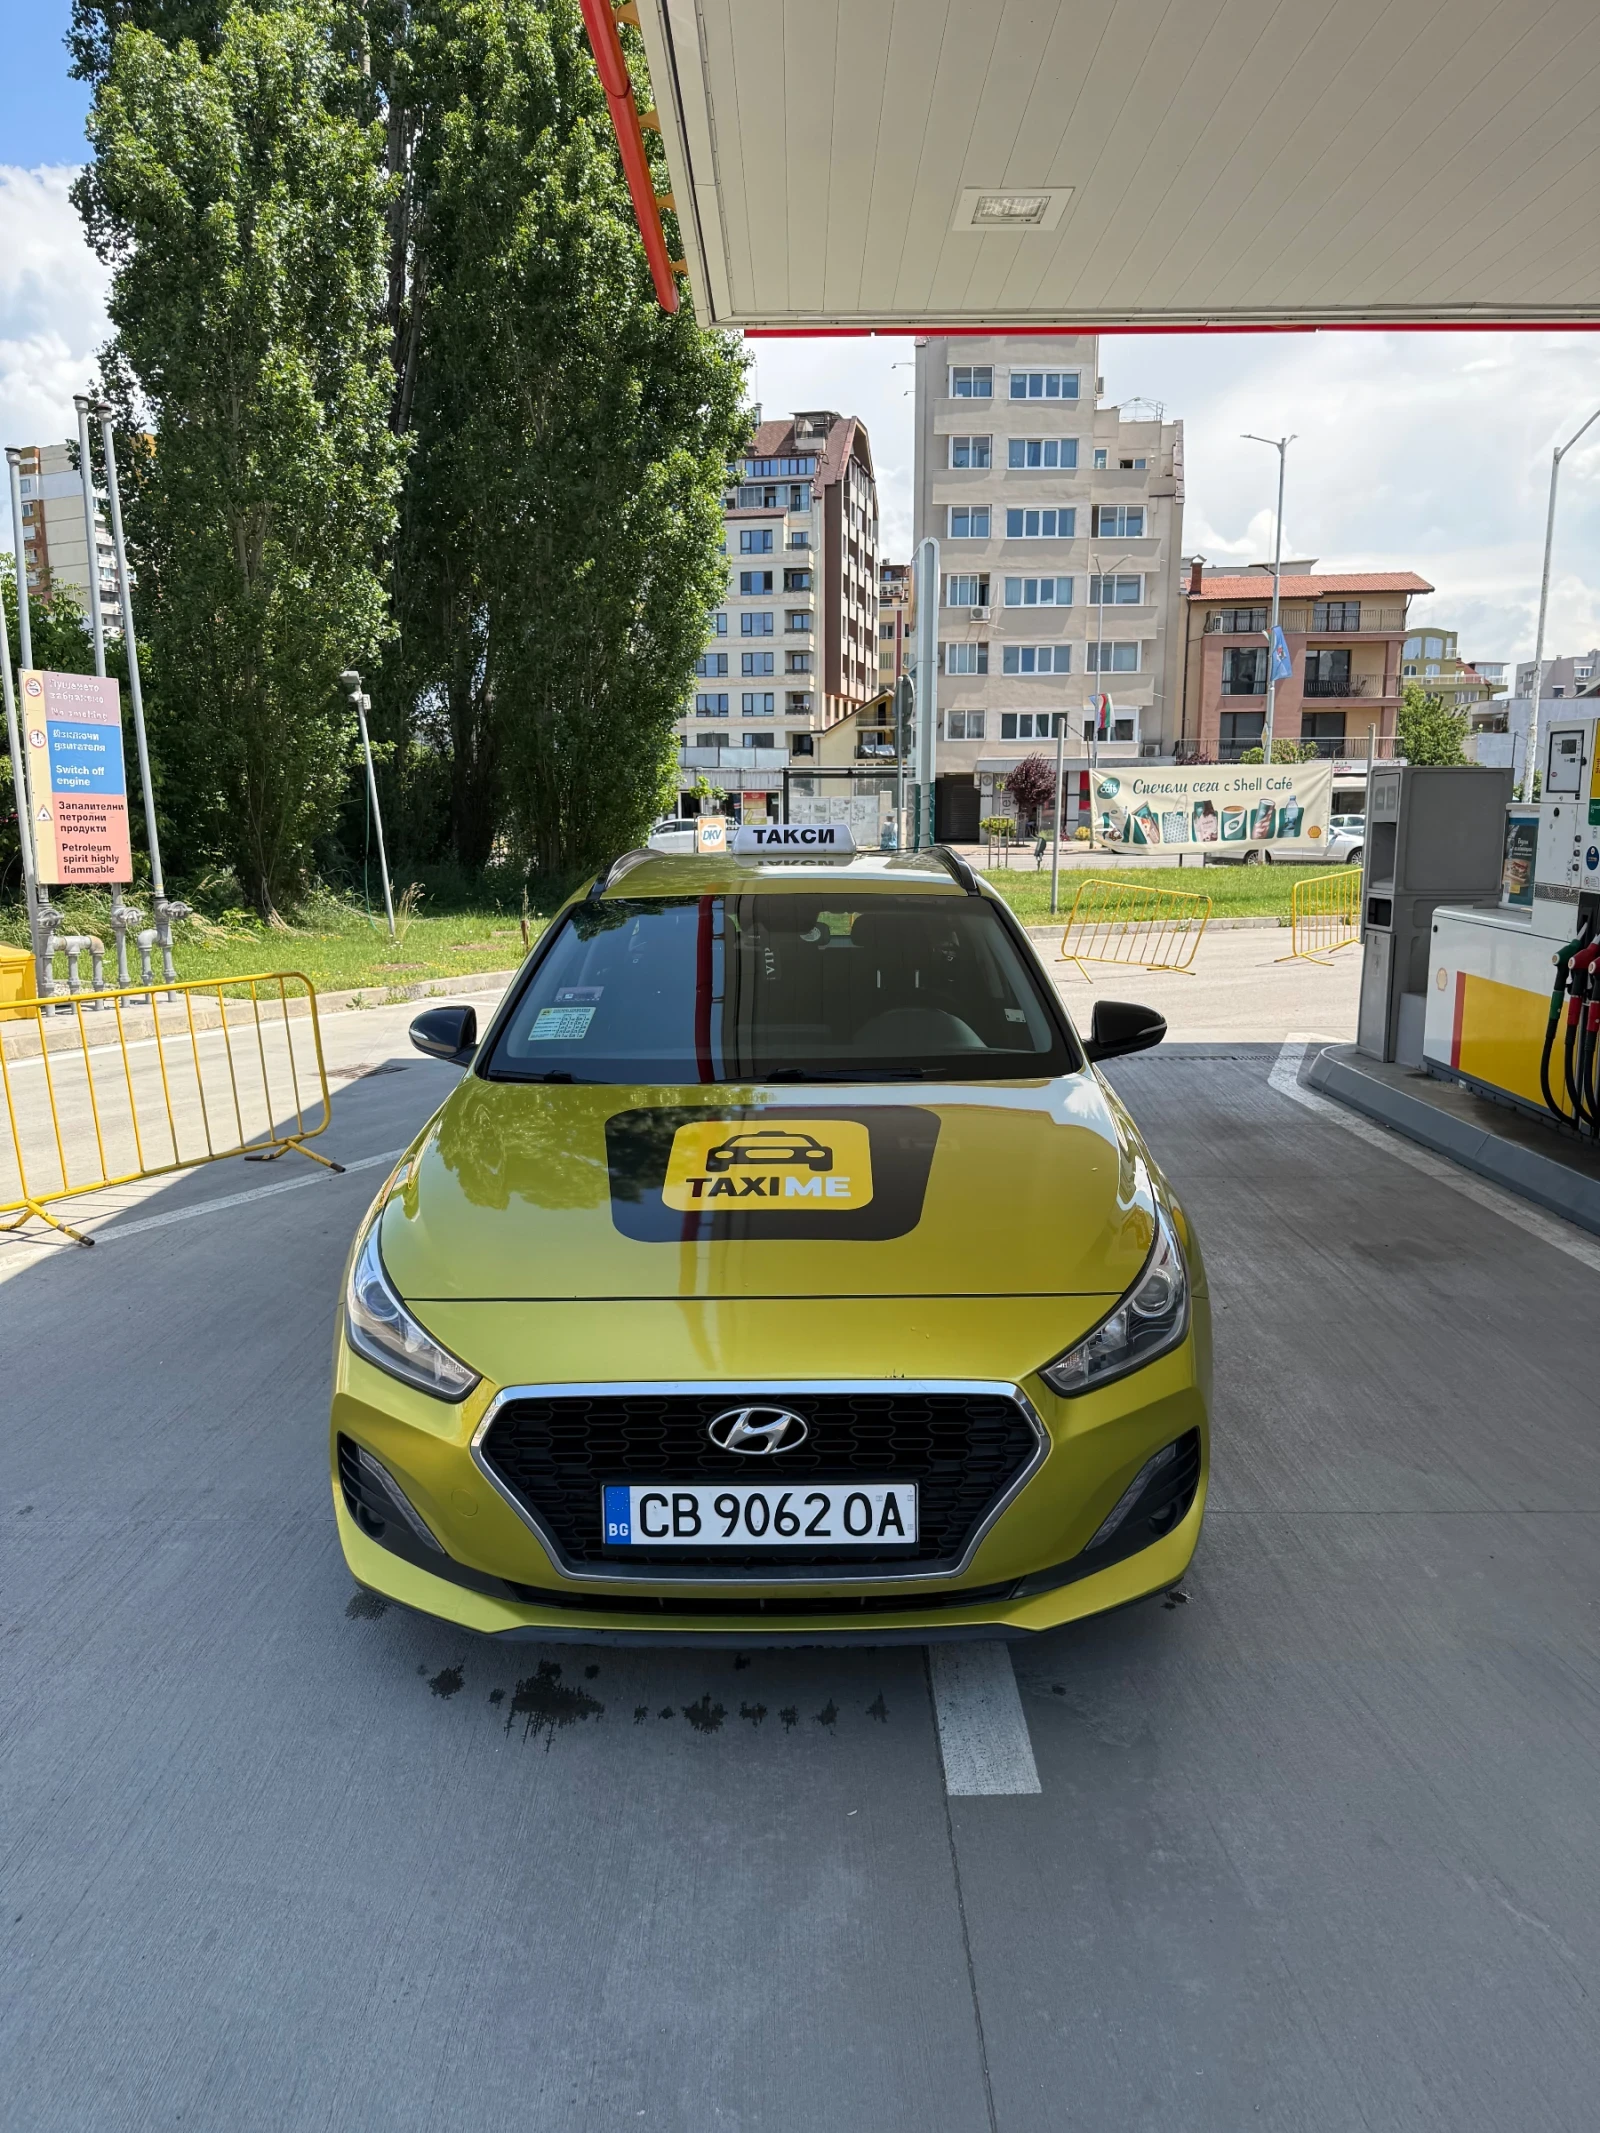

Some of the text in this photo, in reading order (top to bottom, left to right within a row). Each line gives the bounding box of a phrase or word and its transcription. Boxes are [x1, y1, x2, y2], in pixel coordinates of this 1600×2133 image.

[68, 709, 108, 722] smoking
[53, 728, 100, 741] Изключи
[56, 764, 105, 776] Switch off
[56, 776, 91, 787] engine
[1132, 779, 1189, 795] Спечели
[1192, 782, 1220, 793] сега
[1233, 777, 1262, 791] Shell
[1266, 777, 1293, 791] Café
[58, 800, 125, 811] Запалителни
[59, 814, 107, 823] петролни
[60, 825, 107, 834] продукти
[703, 830, 722, 841] DKV
[753, 829, 835, 844] ТАКСИ
[62, 843, 112, 852] Petroleum
[63, 853, 120, 865] spirit highly
[64, 865, 115, 874] flammable
[714, 1493, 831, 1537] 9062
[608, 1522, 629, 1537] BG
